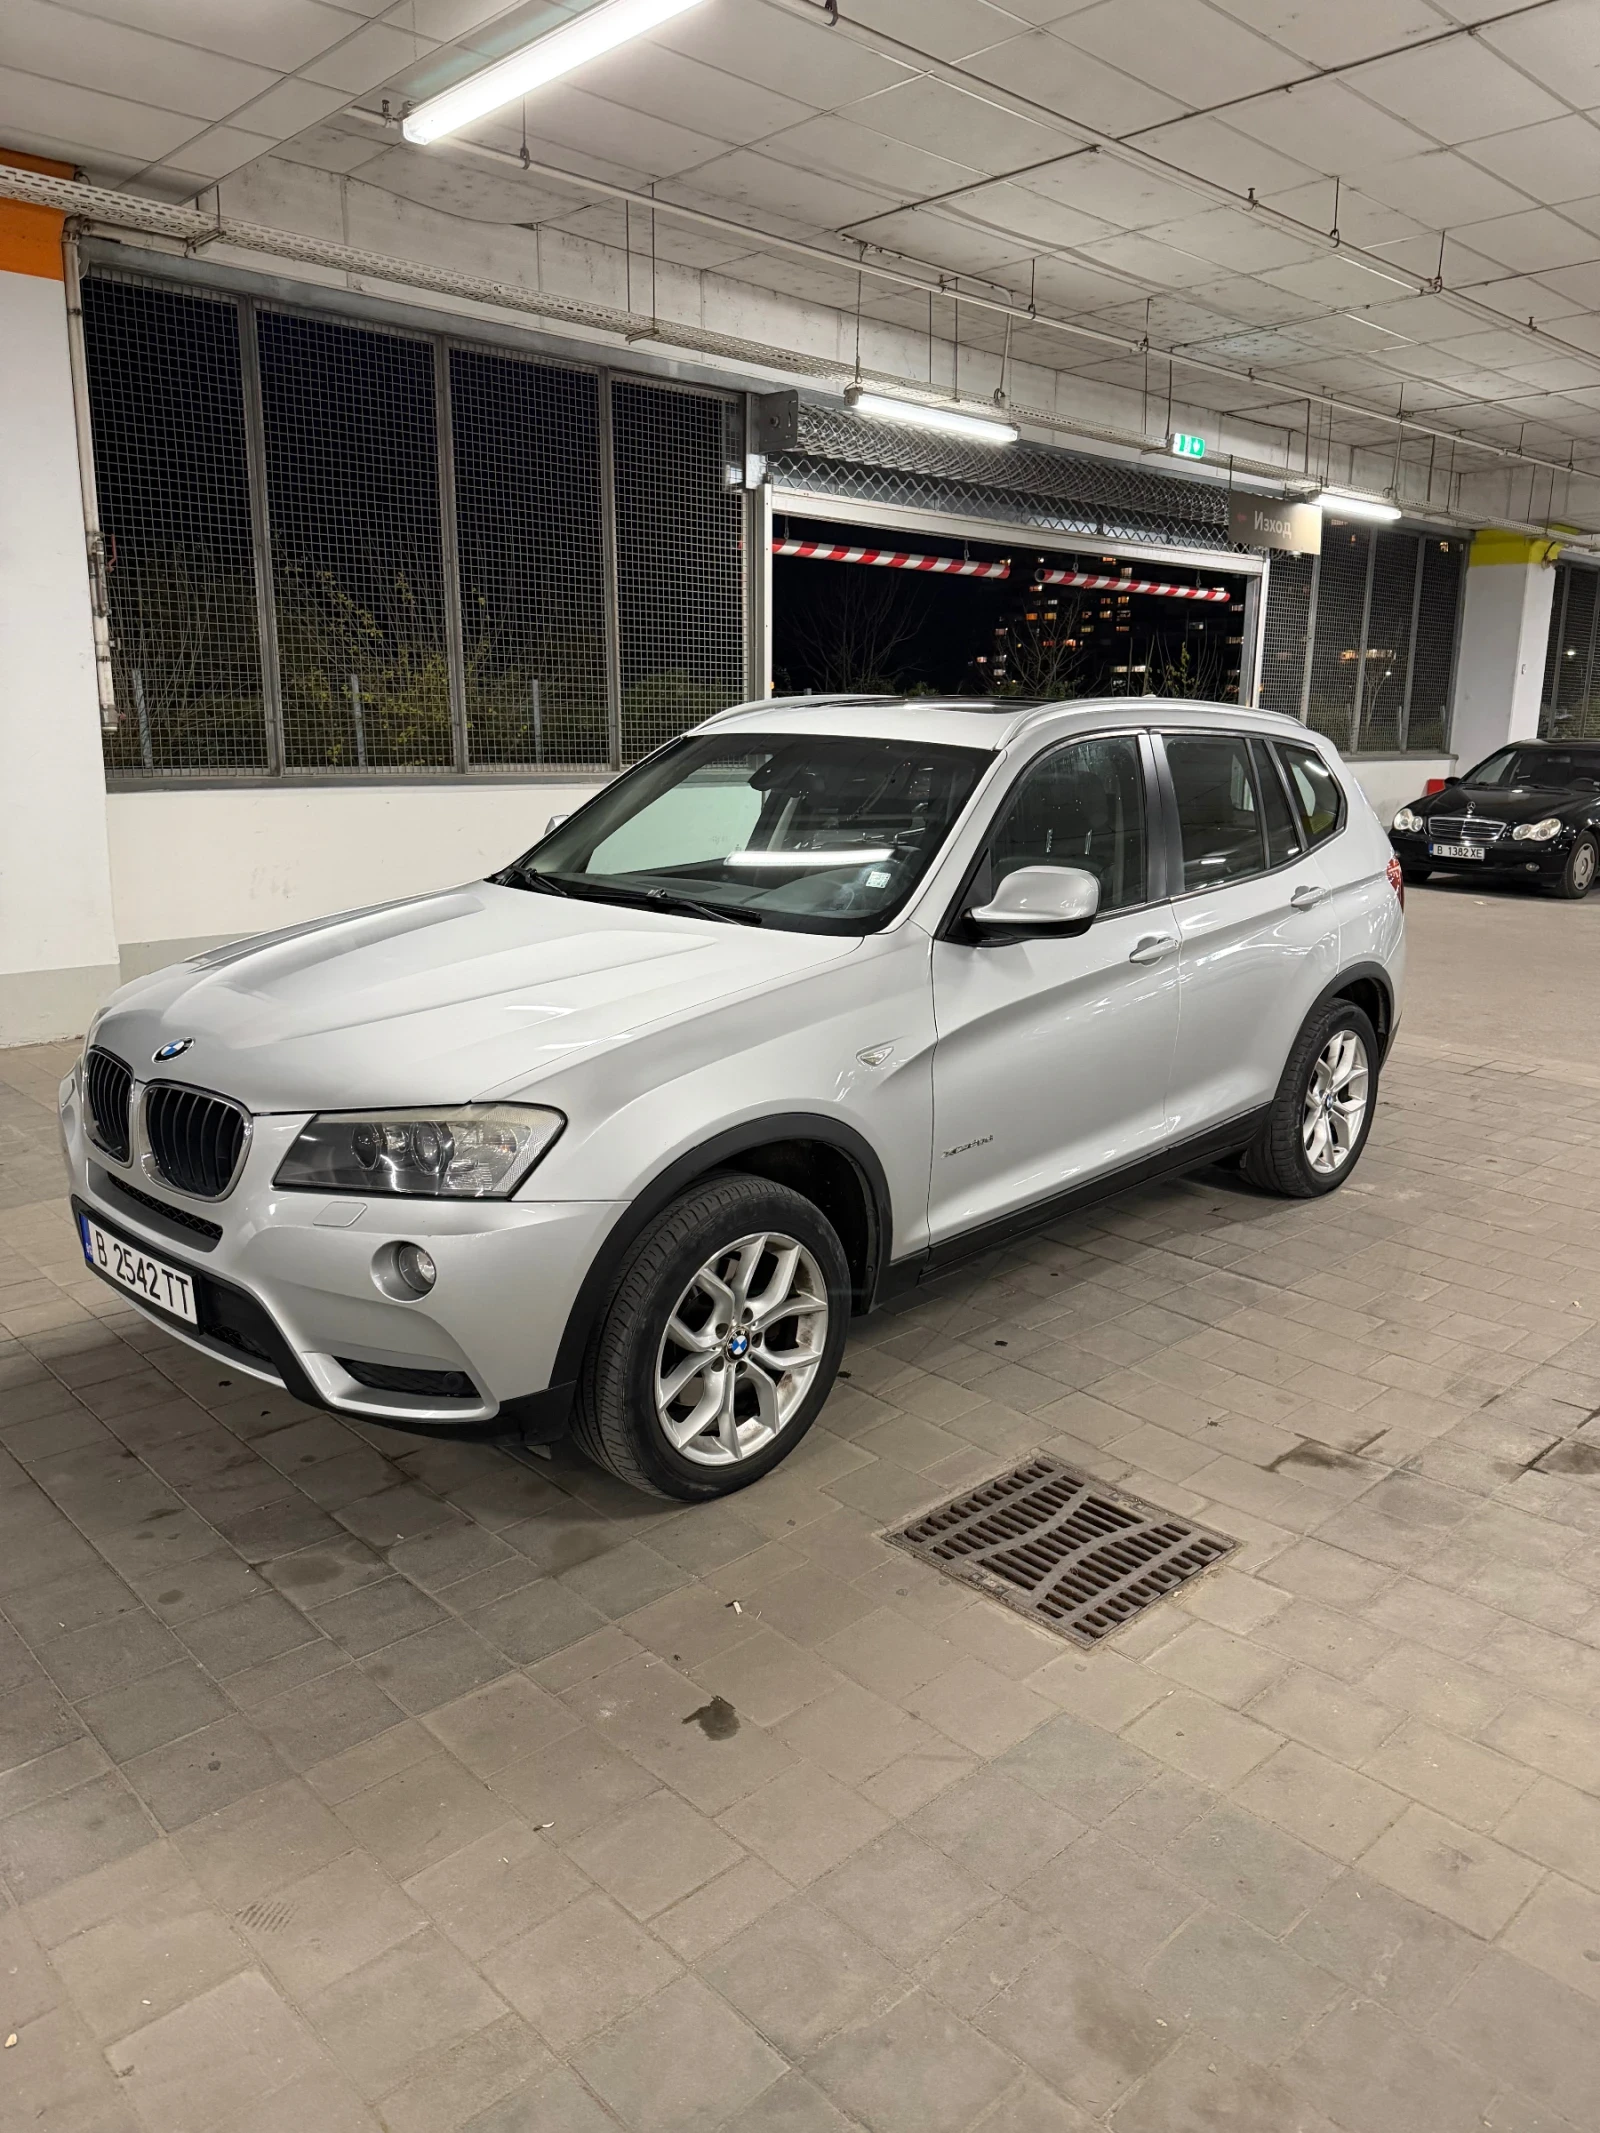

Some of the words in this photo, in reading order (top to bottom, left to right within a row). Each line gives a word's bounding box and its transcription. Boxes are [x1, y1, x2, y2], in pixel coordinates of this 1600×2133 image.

[1254, 510, 1292, 539] Изход
[1437, 845, 1443, 855] B
[1448, 846, 1469, 858] 1382
[1470, 848, 1483, 858] XE
[95, 1230, 108, 1267] B
